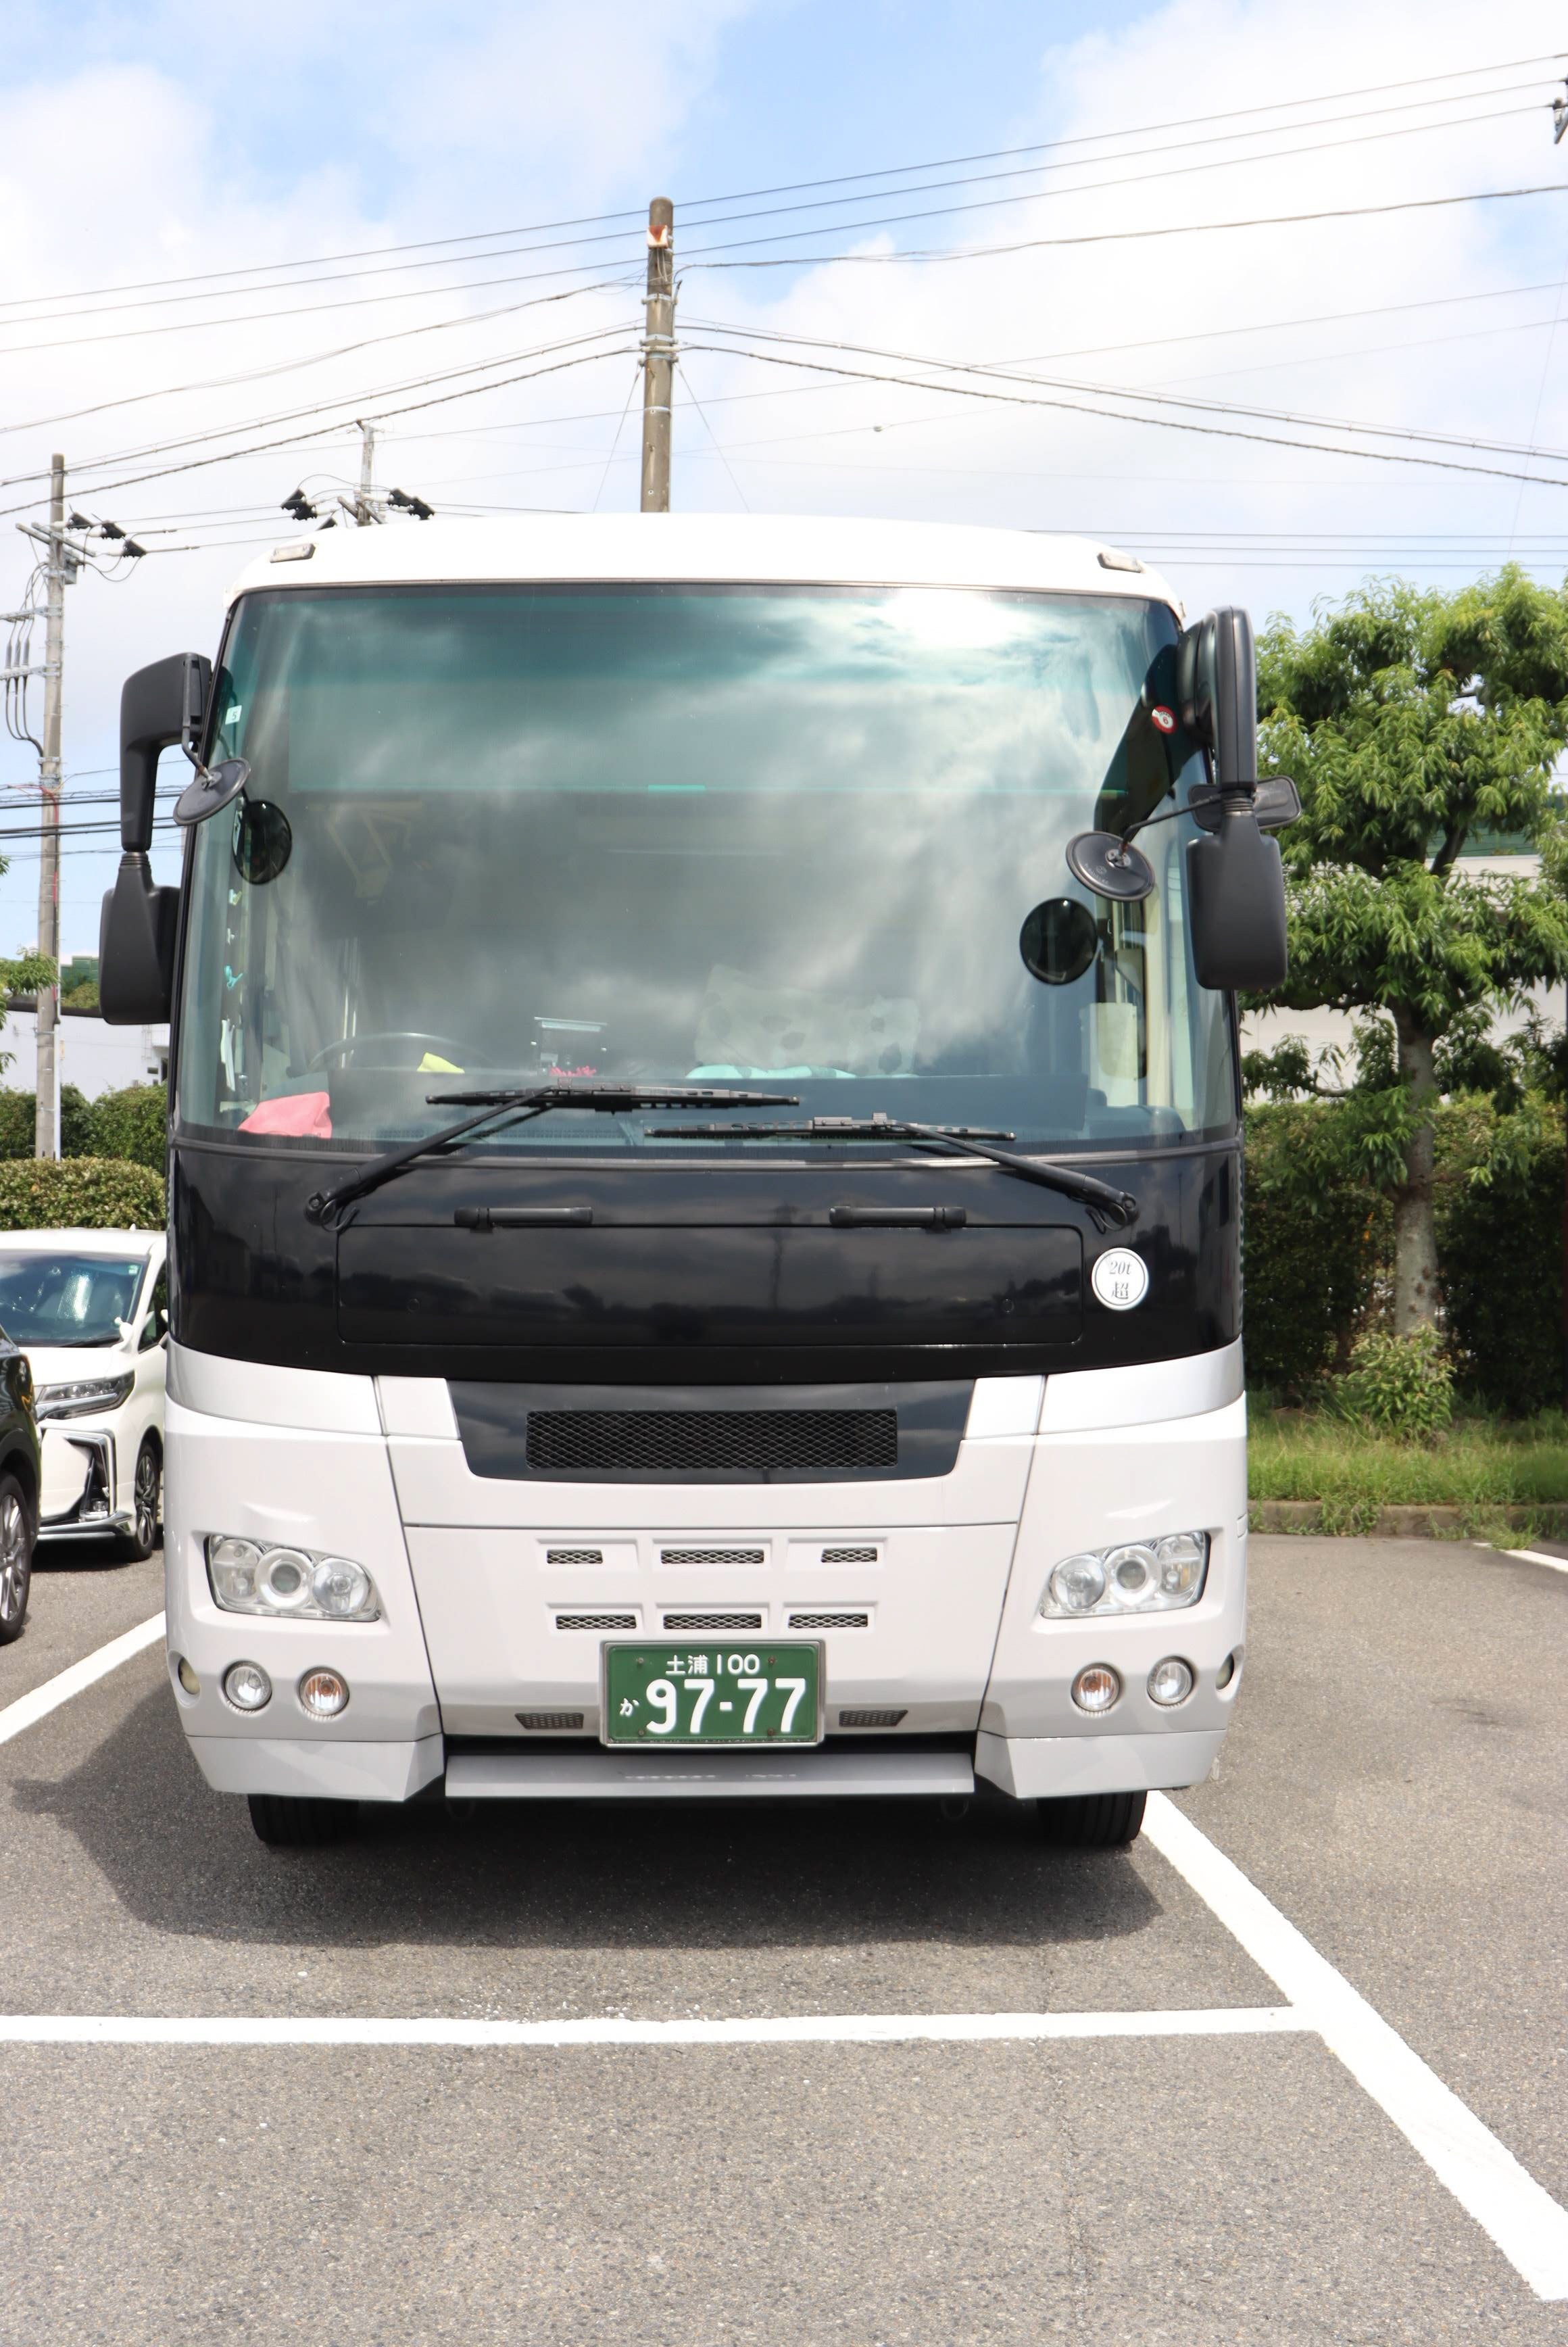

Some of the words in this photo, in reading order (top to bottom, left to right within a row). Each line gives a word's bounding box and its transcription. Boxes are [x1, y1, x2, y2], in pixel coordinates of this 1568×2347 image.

[1109, 1260, 1131, 1275] 20t
[1111, 1281, 1129, 1299] 超
[666, 1655, 708, 1675] 土浦
[717, 1654, 760, 1674] 100
[619, 1698, 639, 1716] か
[646, 1678, 806, 1734] 97-77
